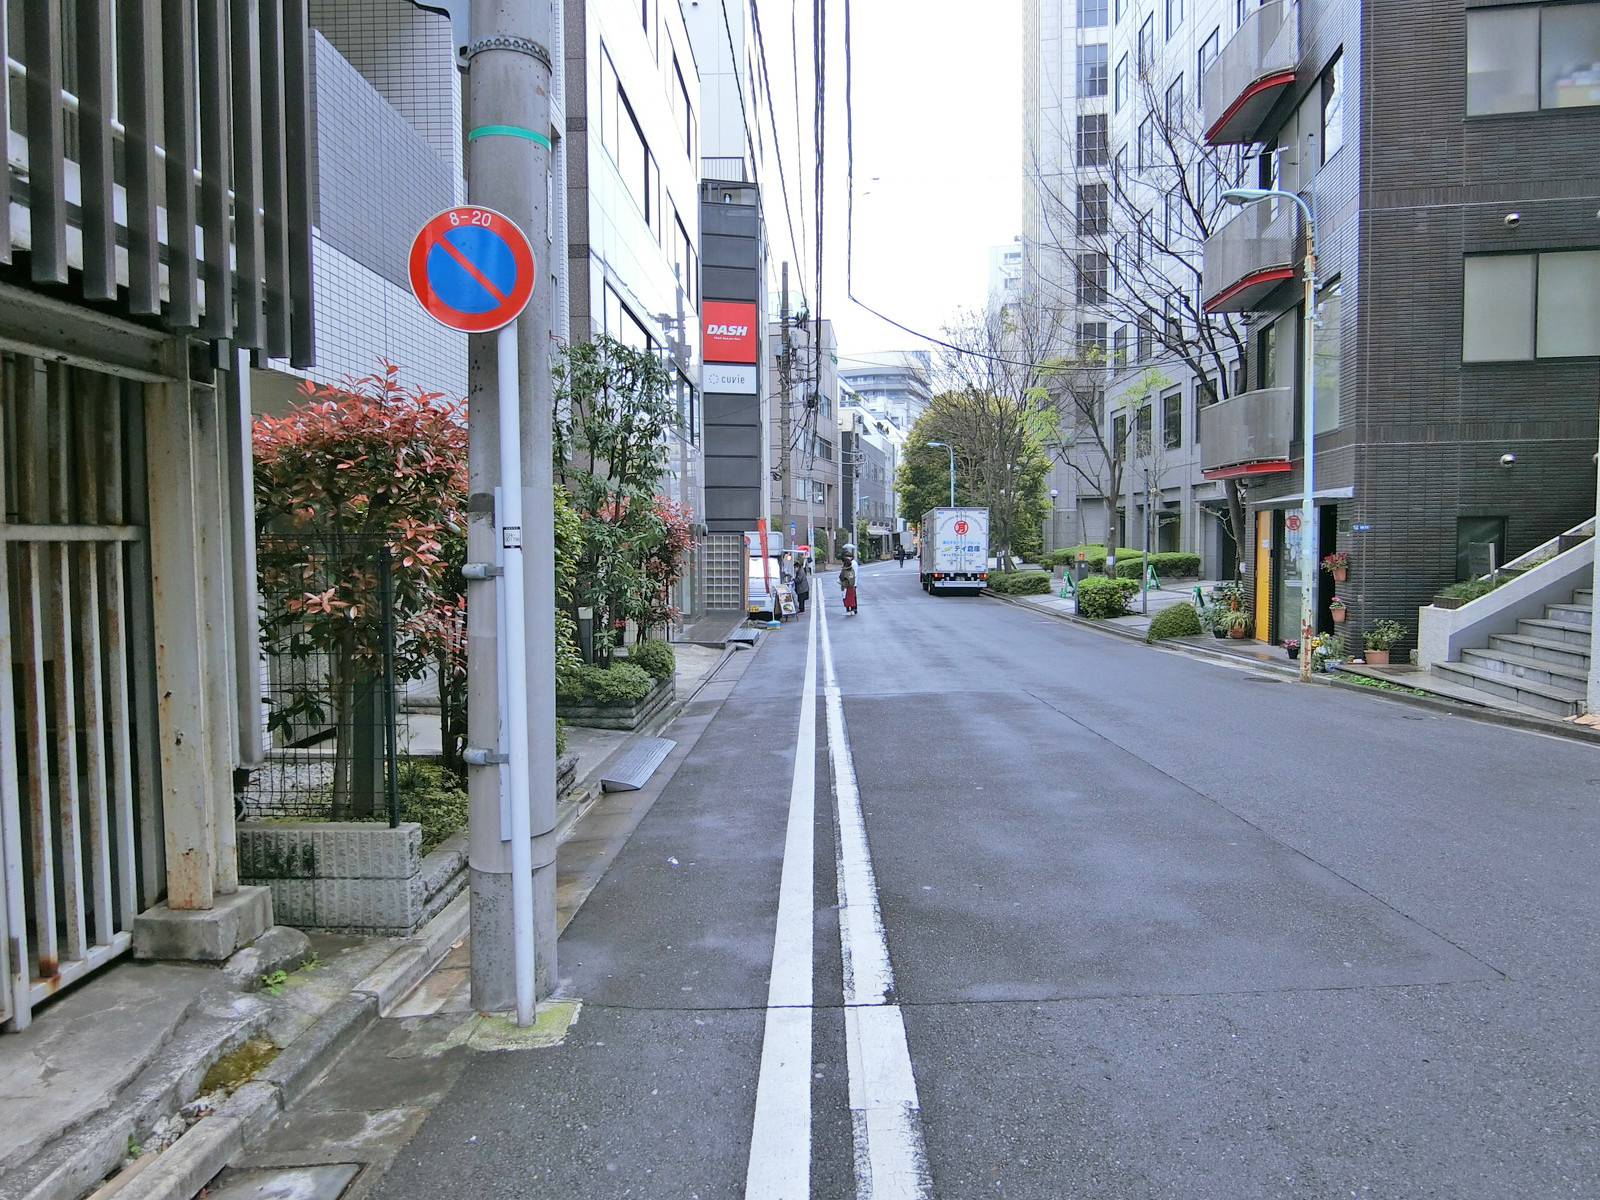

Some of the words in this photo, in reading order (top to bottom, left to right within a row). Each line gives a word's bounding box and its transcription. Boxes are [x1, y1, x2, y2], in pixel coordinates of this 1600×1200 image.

[449, 210, 492, 227] 8-20
[706, 324, 748, 336] DASH
[721, 374, 746, 384] cuvie
